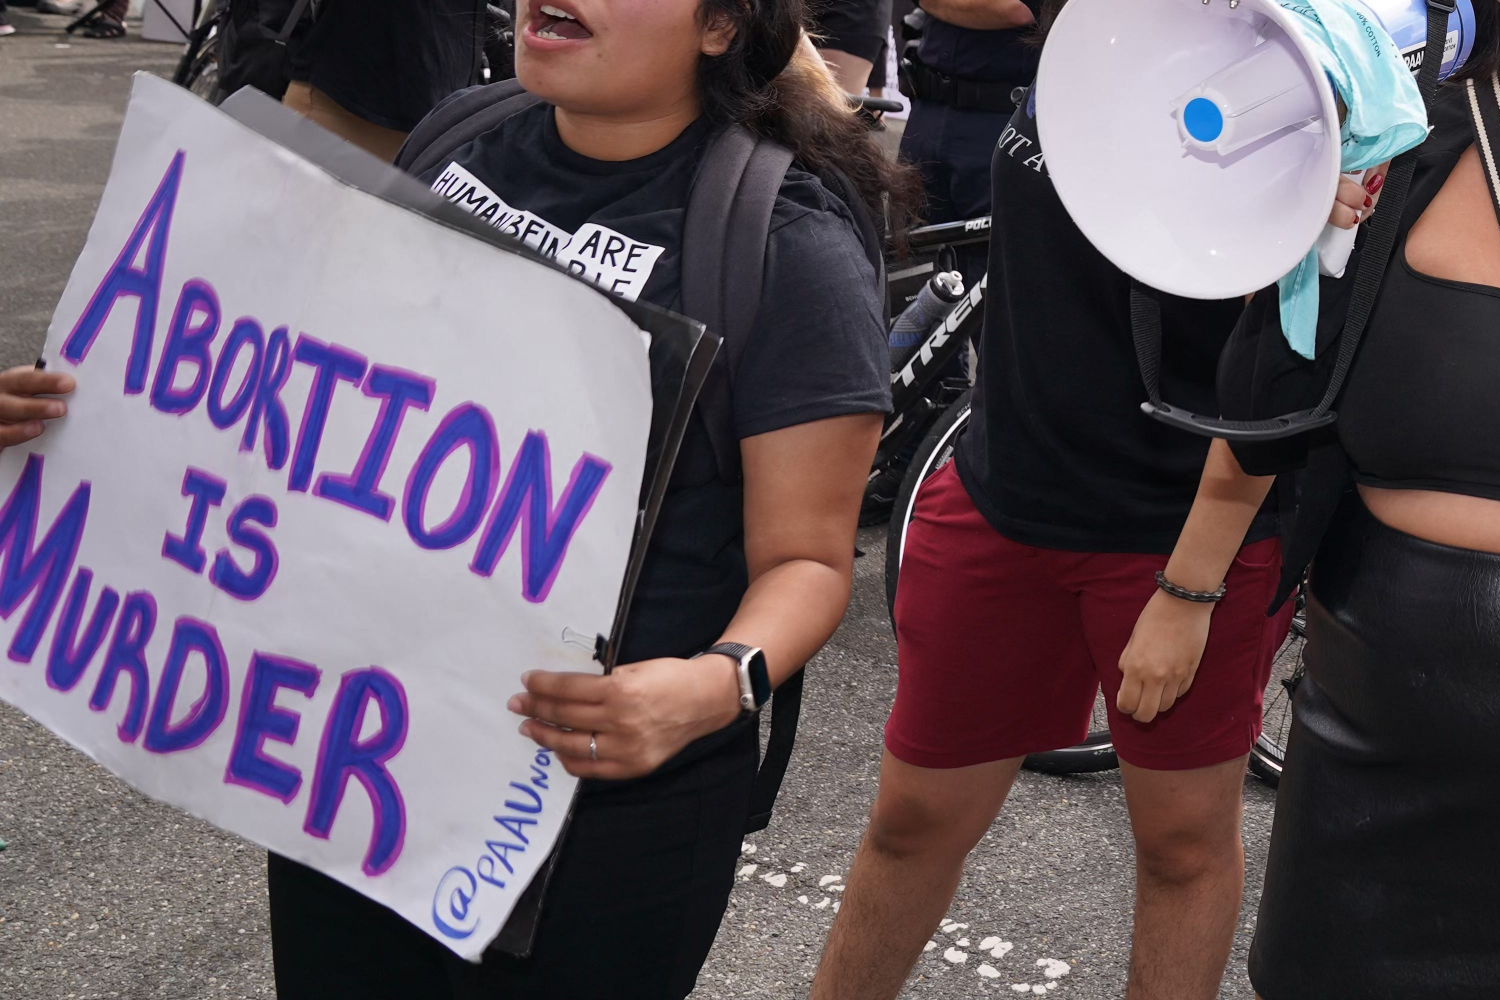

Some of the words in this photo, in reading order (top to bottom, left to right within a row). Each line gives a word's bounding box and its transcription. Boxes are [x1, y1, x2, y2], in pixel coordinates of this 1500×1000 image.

[1365, 26, 1382, 57] COTTON
[999, 123, 1032, 157] OT
[503, 214, 572, 260] BEIN
[578, 230, 649, 273] ARE
[63, 148, 612, 603] ABORTION
[161, 466, 280, 602] IS
[0, 454, 411, 878] MURDER
[432, 747, 554, 940] @PAAUNO
